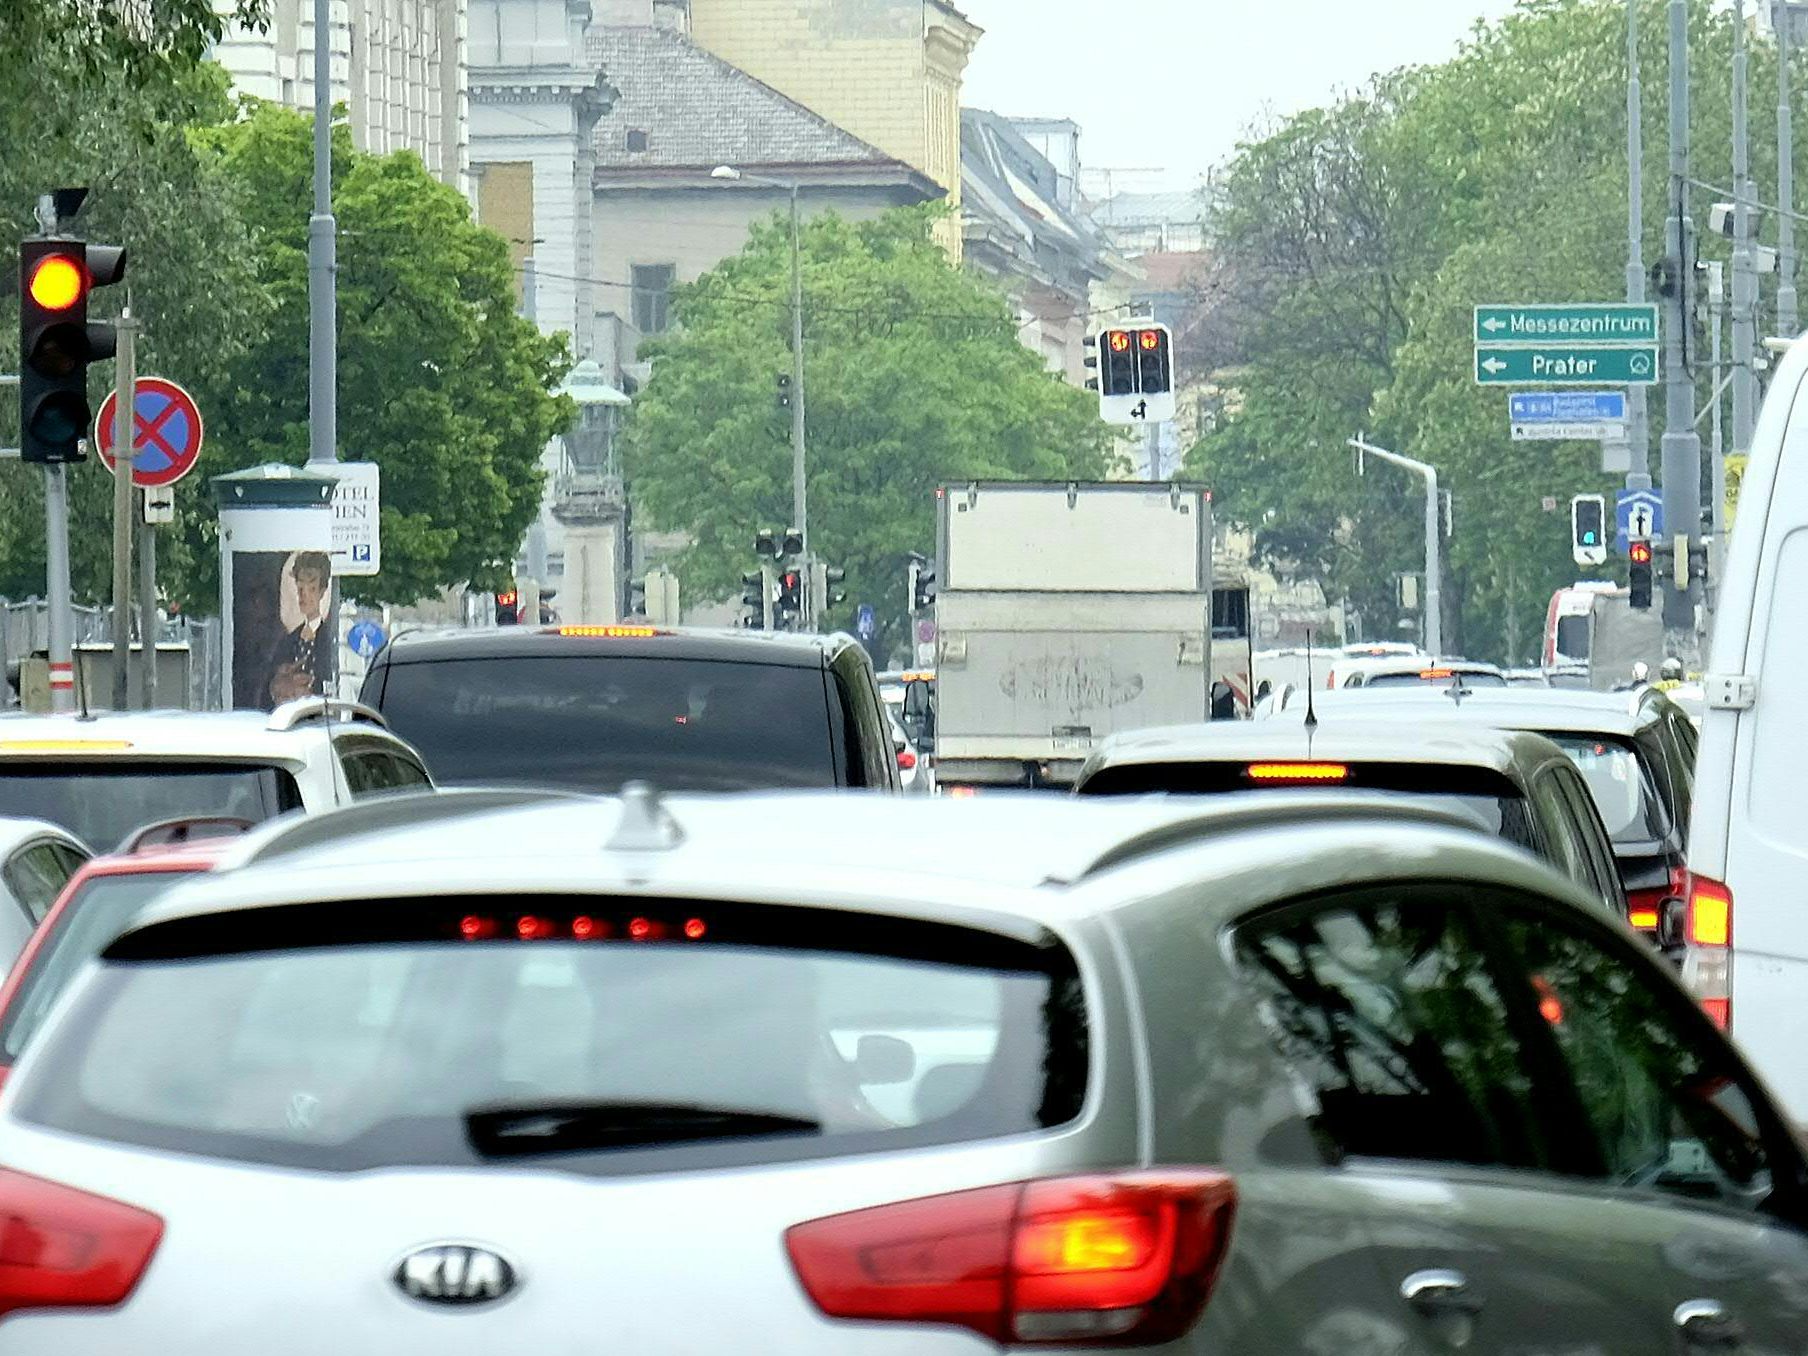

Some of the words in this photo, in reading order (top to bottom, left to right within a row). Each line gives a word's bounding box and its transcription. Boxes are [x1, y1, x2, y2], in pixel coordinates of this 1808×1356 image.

[1510, 313, 1650, 333] Messezentrum
[1532, 354, 1597, 375] Prater
[355, 545, 368, 560] P
[404, 1253, 504, 1297] KIA
